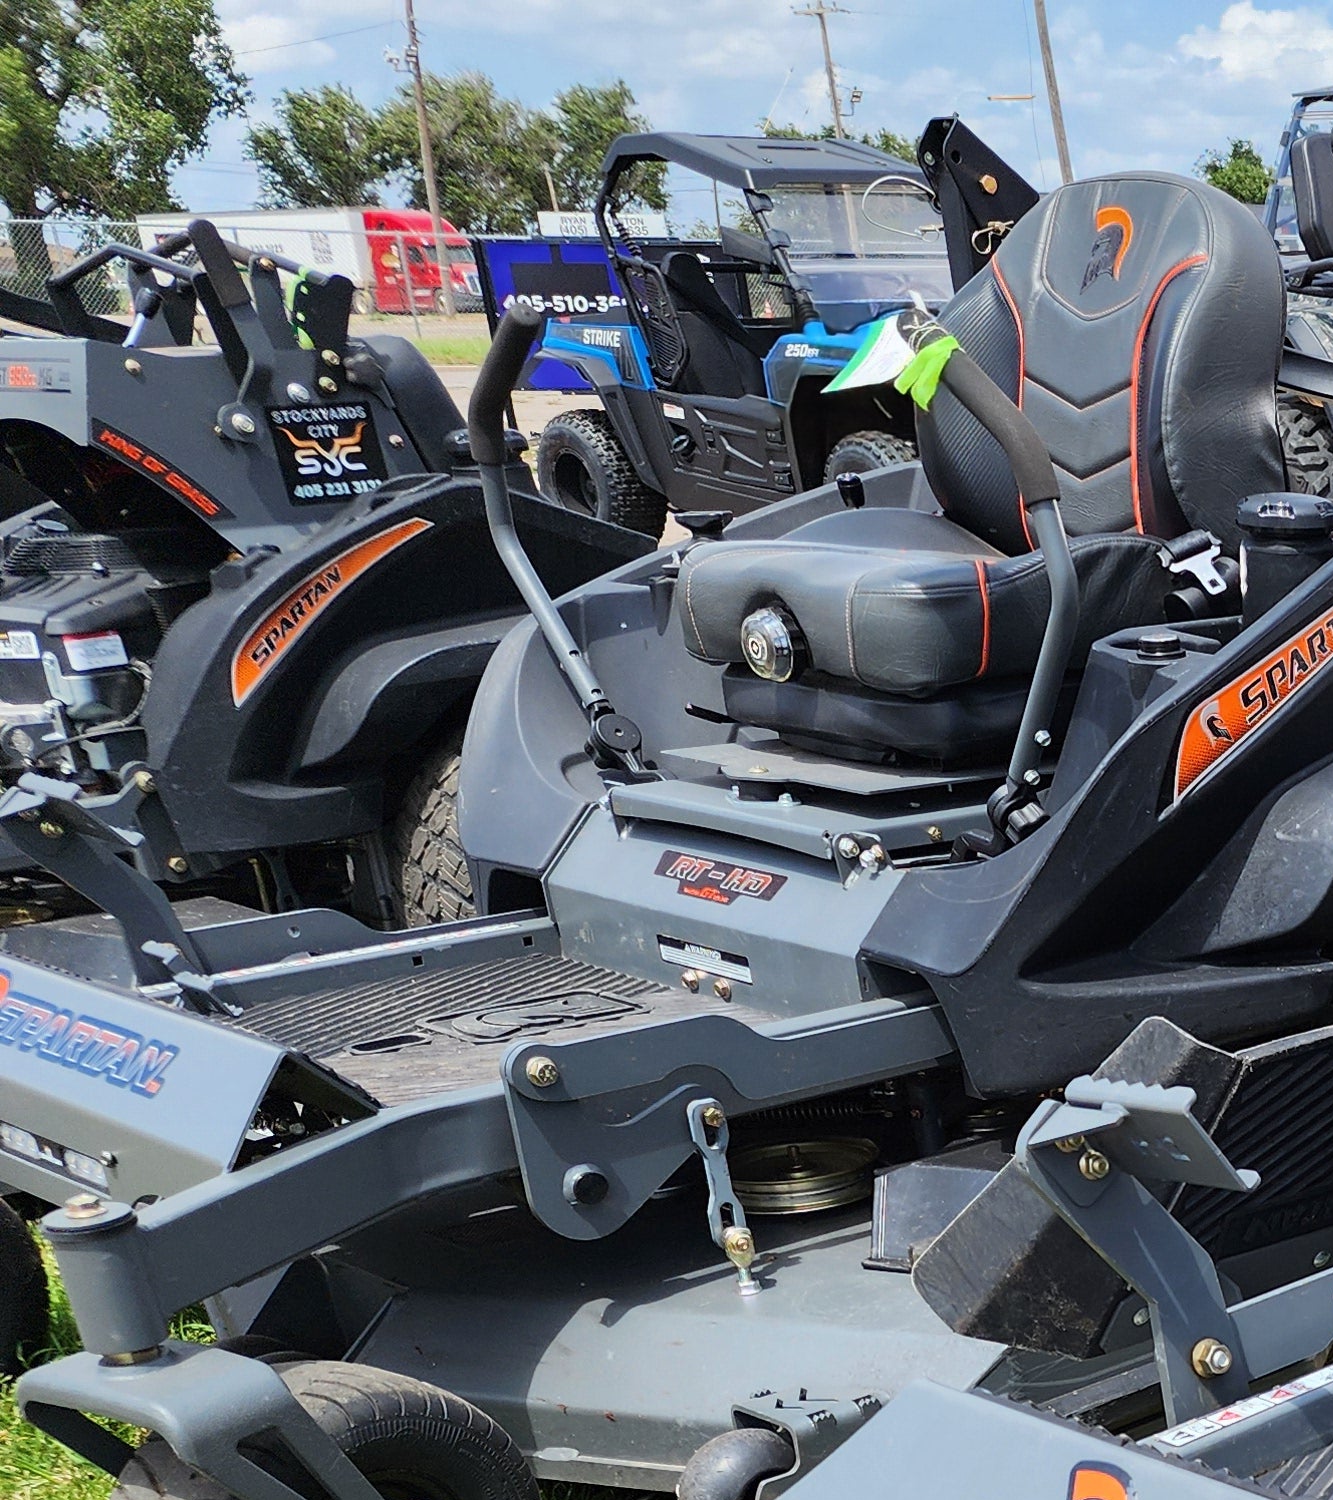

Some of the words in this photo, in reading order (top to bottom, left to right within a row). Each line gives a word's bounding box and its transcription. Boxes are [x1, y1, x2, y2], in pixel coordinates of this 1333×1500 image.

[560, 216, 586, 226] RYAN
[583, 328, 622, 347] STRIKE
[271, 406, 367, 424] STOCKYARDS
[307, 423, 339, 439] CITY
[294, 483, 325, 499] 405
[324, 481, 352, 496] 231
[250, 564, 342, 669] SPARTAN
[0, 996, 176, 1094] SPARTAN
